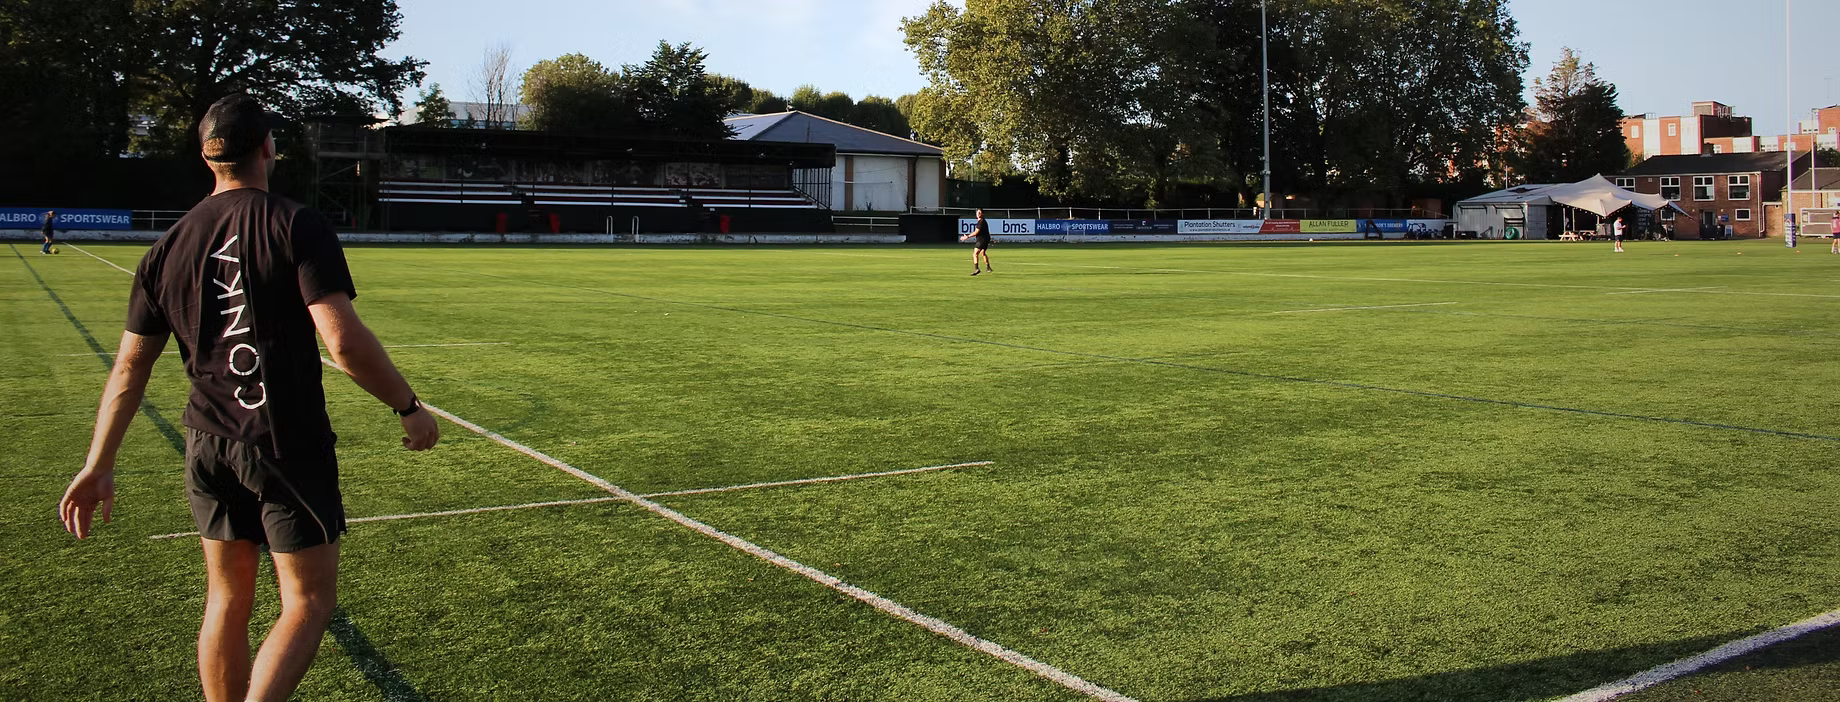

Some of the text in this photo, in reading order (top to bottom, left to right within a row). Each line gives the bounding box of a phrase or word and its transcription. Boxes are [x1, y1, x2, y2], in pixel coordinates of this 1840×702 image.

[0, 213, 130, 224] ALBRO SPORTSWEAR
[1002, 219, 1030, 233] bms.
[1212, 220, 1236, 228] Shutters
[1308, 220, 1327, 228] ALLAN
[1327, 220, 1349, 228] FULLER
